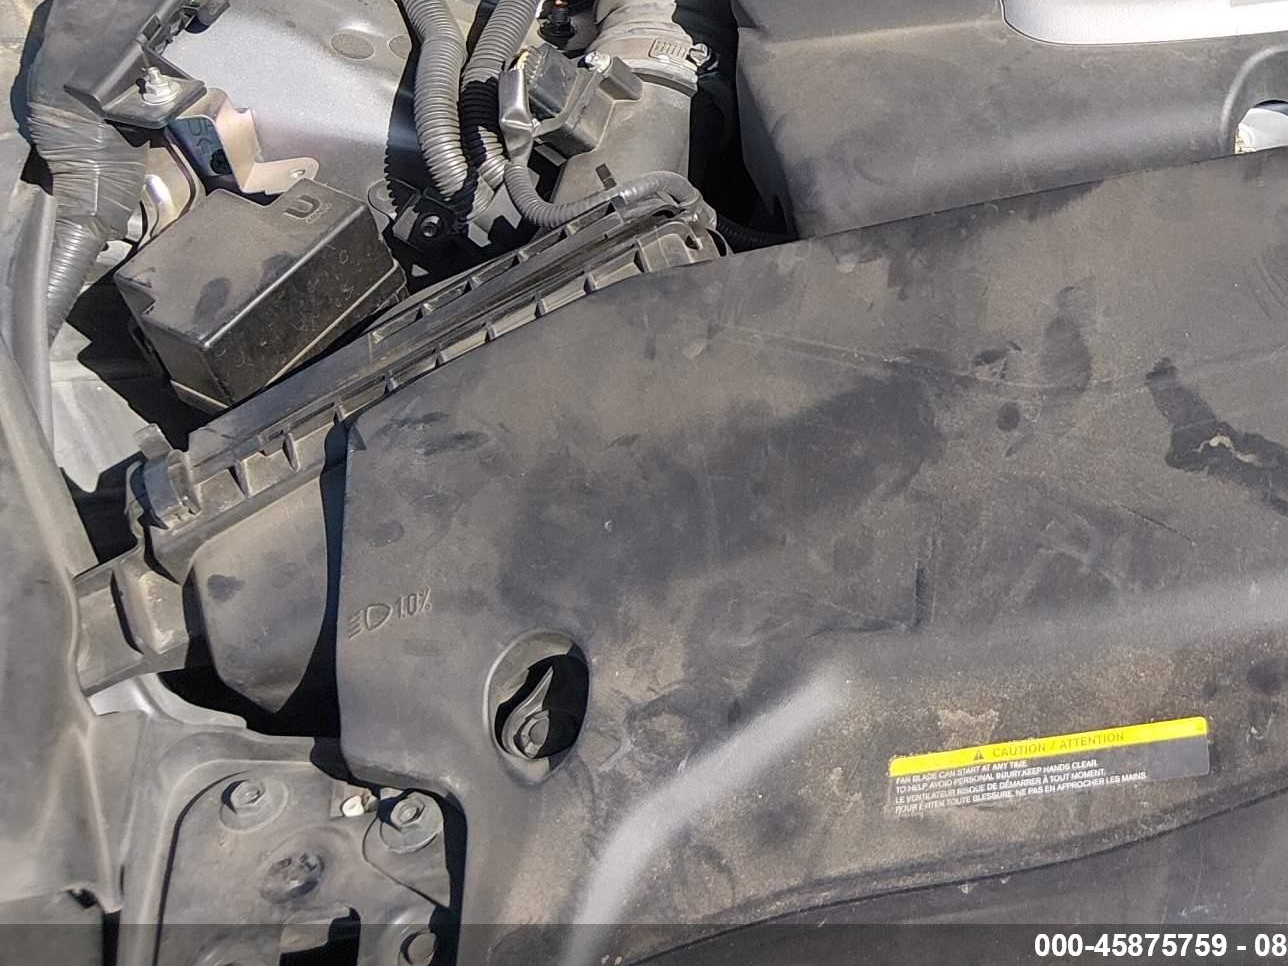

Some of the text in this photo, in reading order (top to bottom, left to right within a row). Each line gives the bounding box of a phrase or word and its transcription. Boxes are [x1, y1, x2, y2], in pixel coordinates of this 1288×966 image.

[992, 743, 1046, 757] CAUTION
[1060, 730, 1124, 749] ATTENTION
[929, 779, 952, 789] AVOID
[953, 772, 994, 785] PERSONAL
[1043, 762, 1071, 773] HANDS
[939, 769, 956, 778] CAN
[957, 765, 980, 775] START
[992, 762, 1008, 771] ANY
[906, 789, 955, 802] VENTILATEUR
[987, 782, 997, 791] DE
[1049, 773, 1069, 783] TOUT
[1015, 788, 1026, 797] NE
[1027, 785, 1043, 794] PAS
[1044, 784, 1056, 793] EN
[1056, 778, 1105, 792] APPROCHER
[1106, 775, 1120, 784] LES
